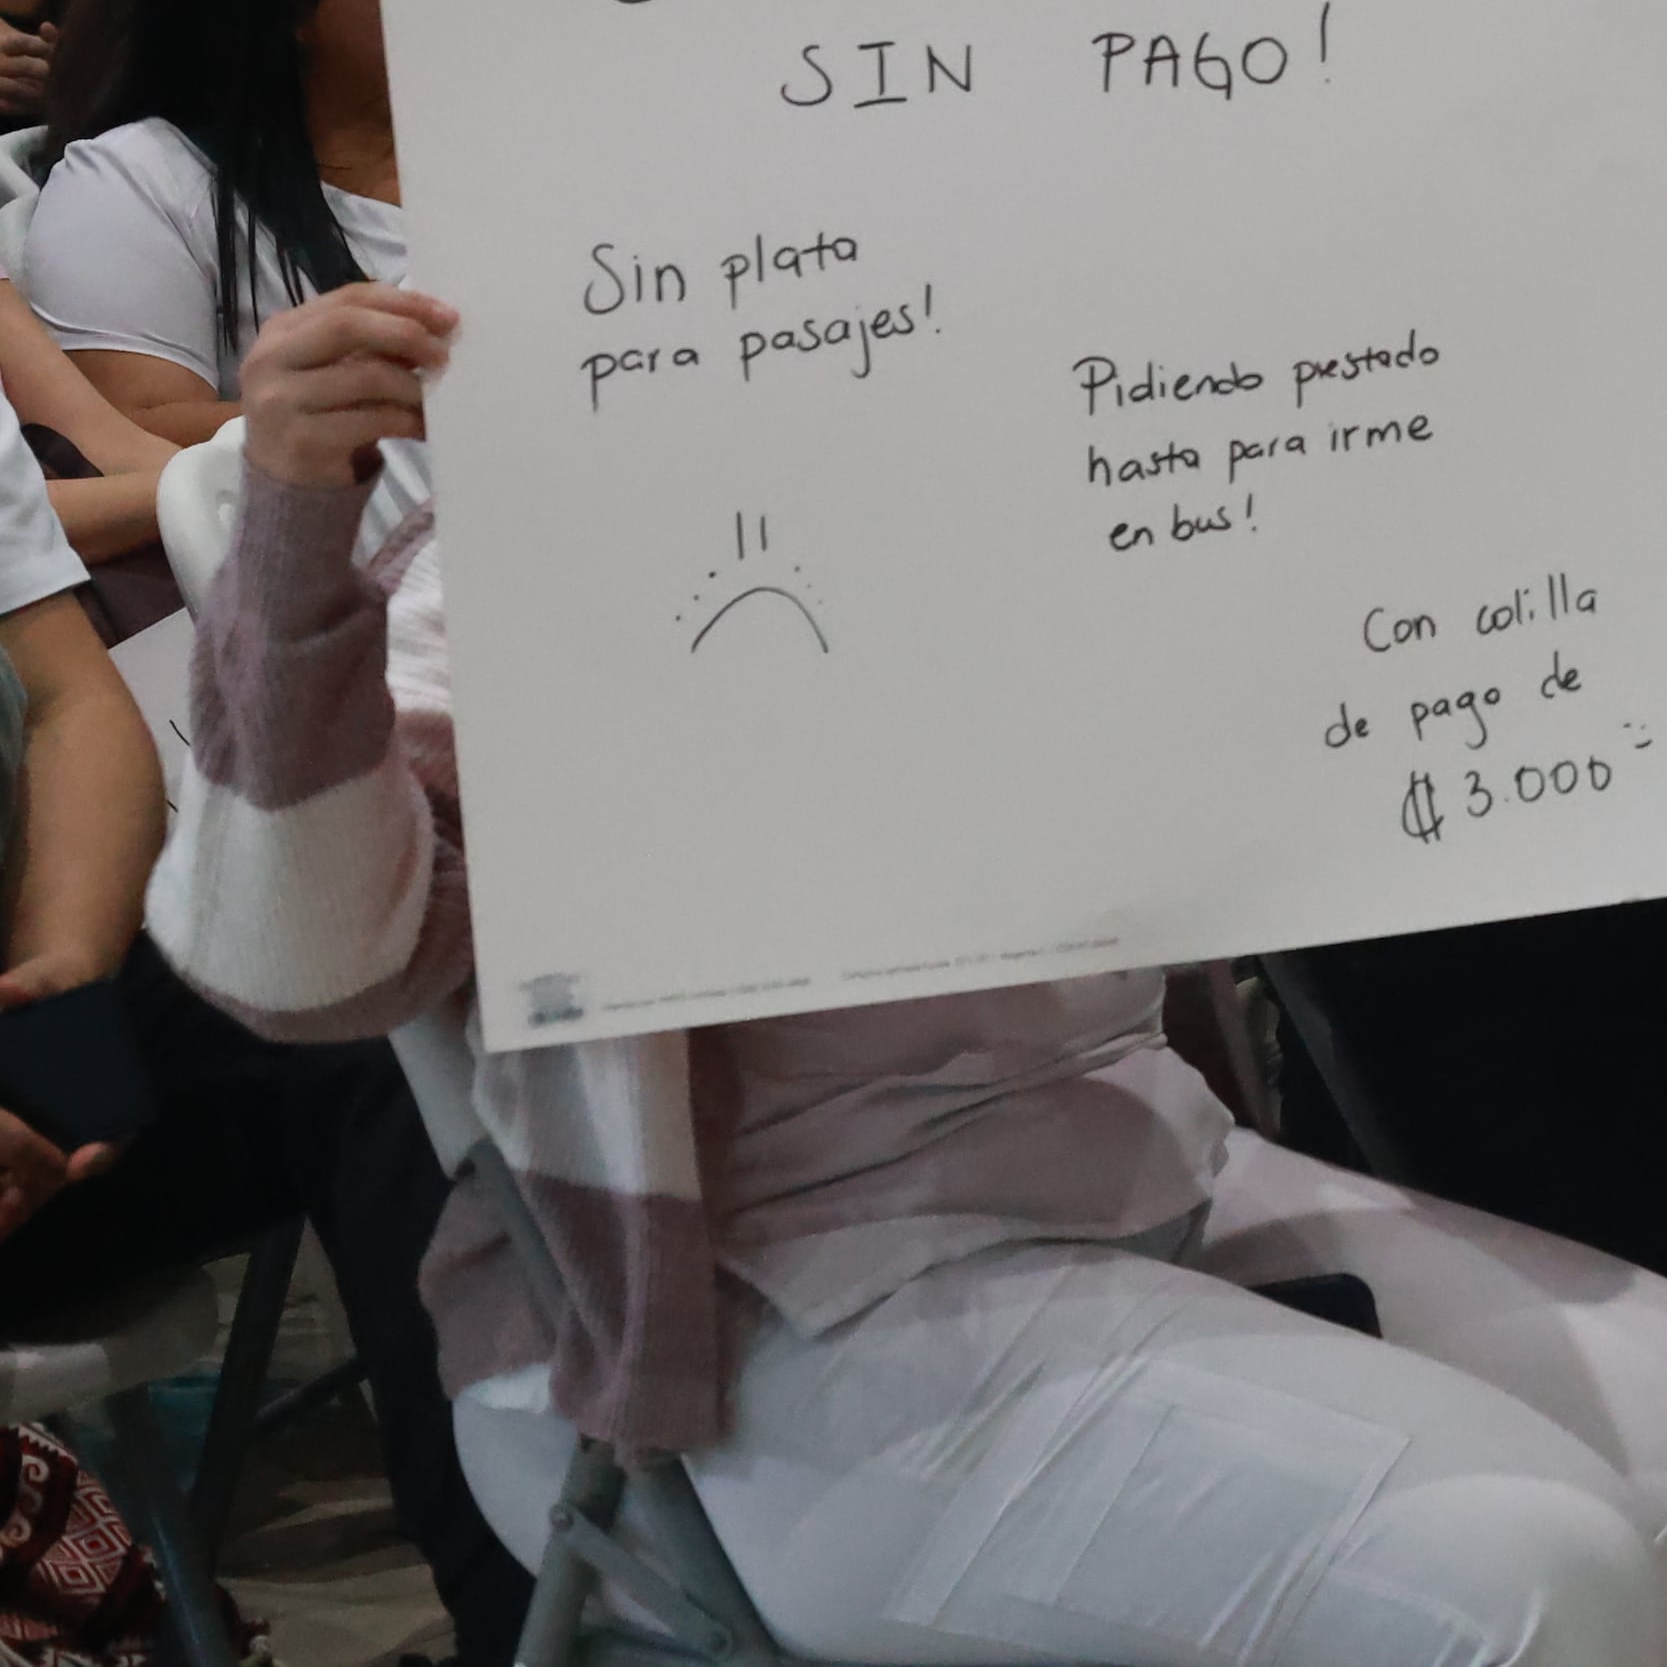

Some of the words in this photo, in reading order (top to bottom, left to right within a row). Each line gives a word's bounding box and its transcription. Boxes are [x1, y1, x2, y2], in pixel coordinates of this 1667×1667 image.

[779, 40, 973, 110] SIN
[1090, 0, 1334, 102] PAGO!
[582, 242, 687, 316] Sin
[719, 230, 859, 311] plata
[579, 347, 701, 414] para
[738, 281, 942, 383] pasajes!
[1071, 355, 1265, 417] Pidiendo
[1087, 440, 1201, 488] hasta
[1228, 434, 1307, 486] para
[1328, 414, 1434, 453] irme
[1107, 521, 1156, 553] en
[1169, 492, 1259, 543] bus!
[1362, 606, 1437, 654] Con
[1475, 571, 1599, 637] colilla
[1323, 701, 1371, 750] de
[1409, 686, 1502, 751] pago
[1539, 649, 1583, 700] de
